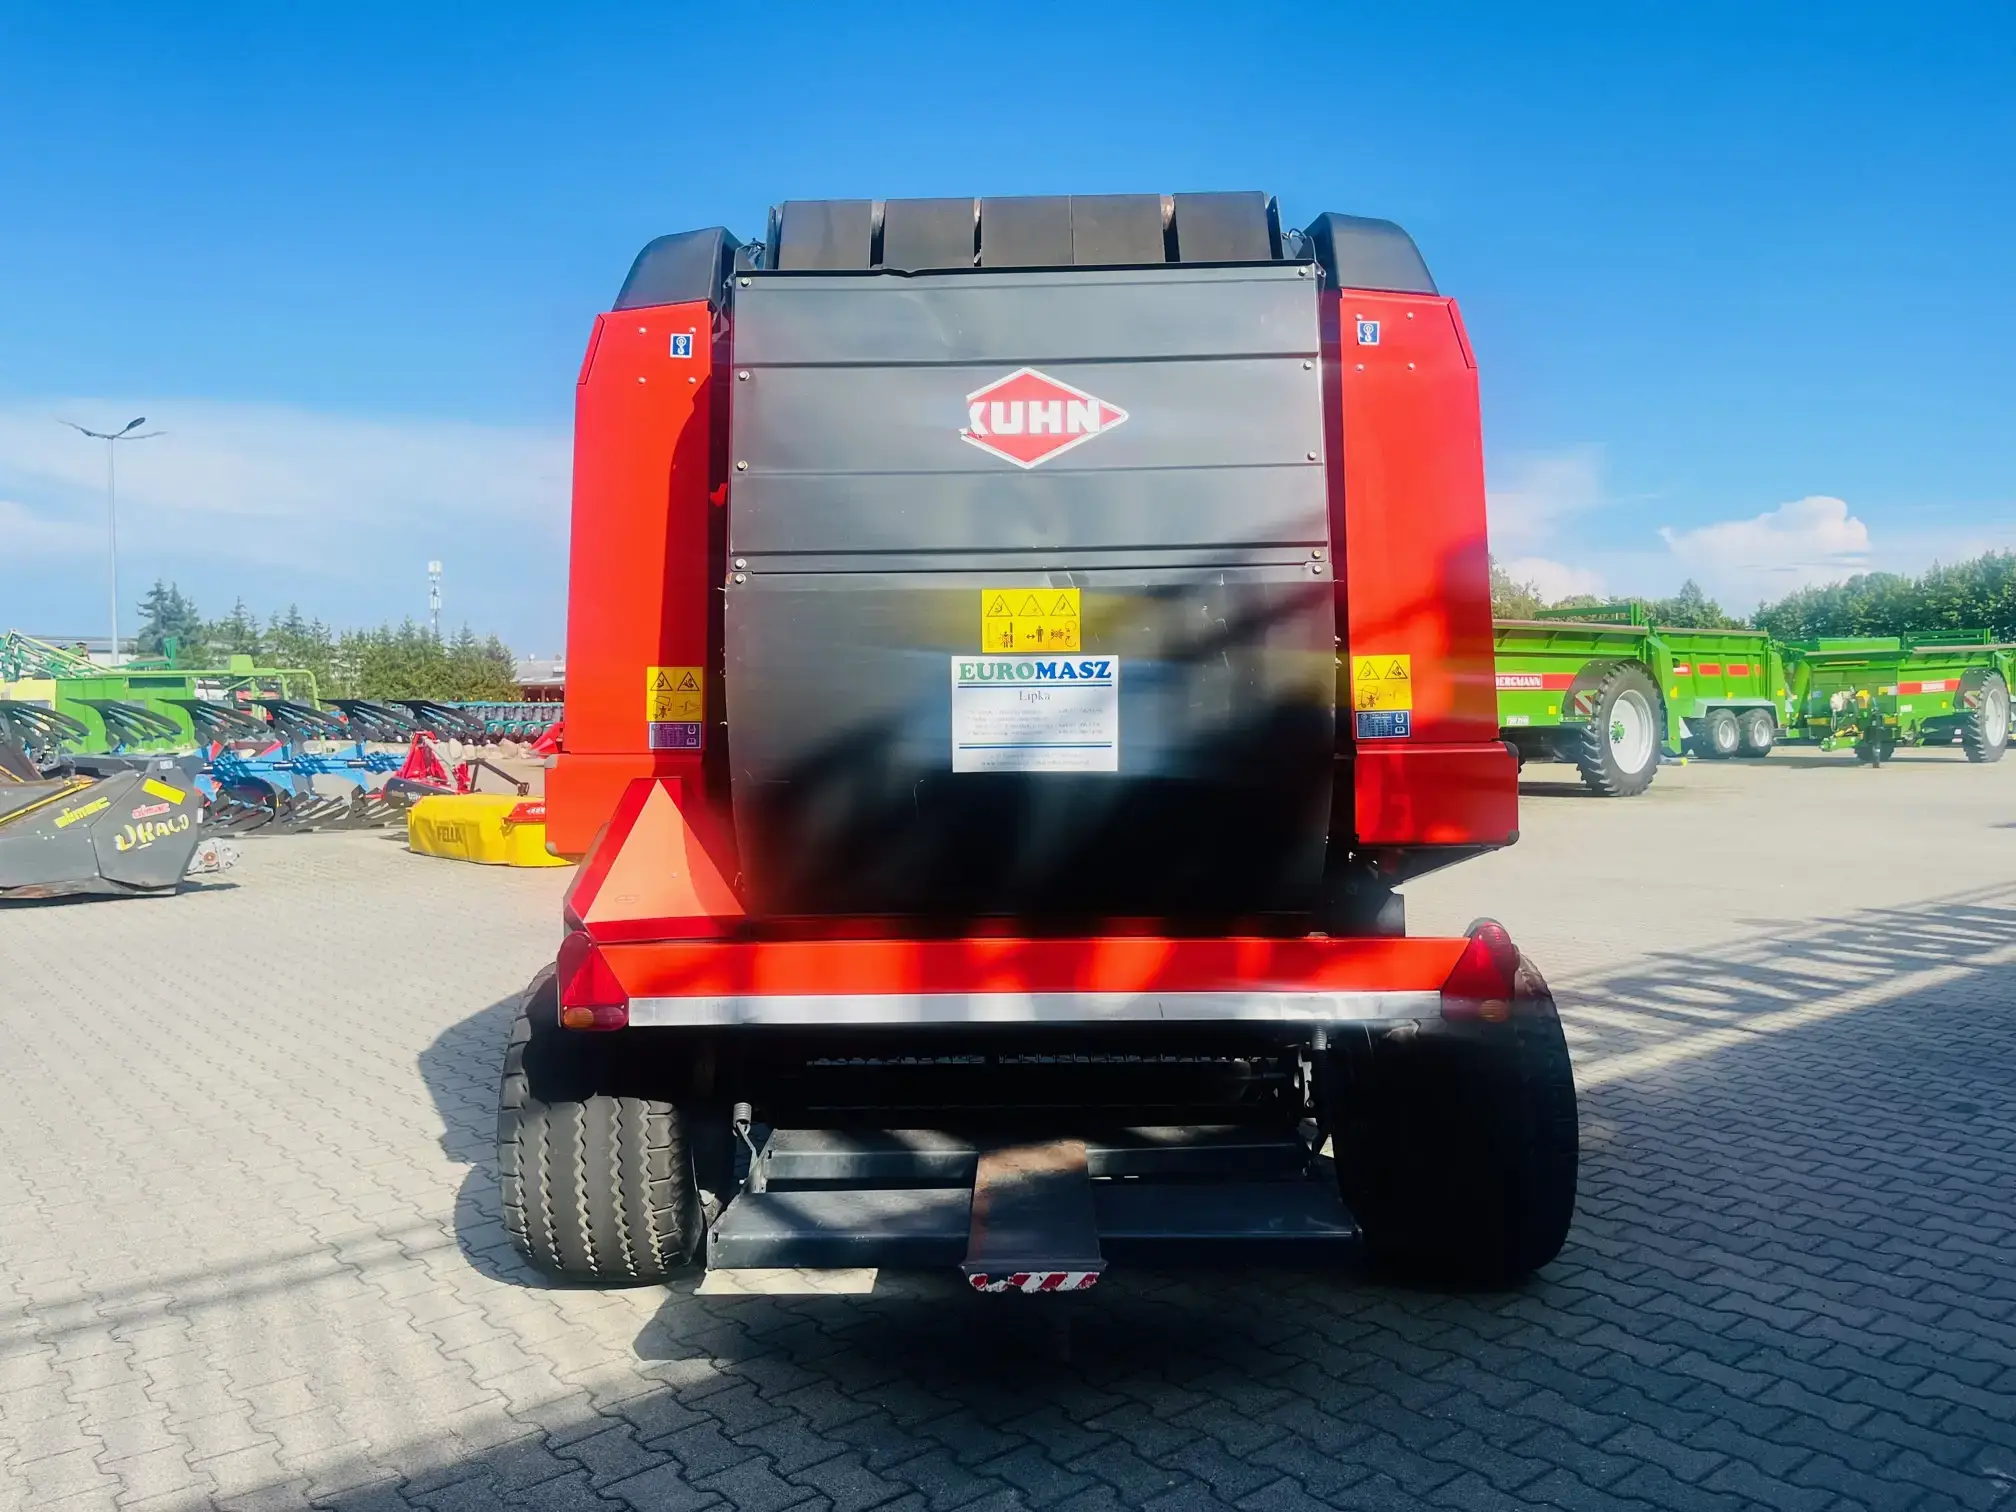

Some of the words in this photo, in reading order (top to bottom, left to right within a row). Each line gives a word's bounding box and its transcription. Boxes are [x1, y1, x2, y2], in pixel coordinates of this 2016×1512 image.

[959, 661, 1112, 681] EUROMASZ
[1019, 691, 1051, 703] Lipka
[437, 825, 463, 844] FELLA
